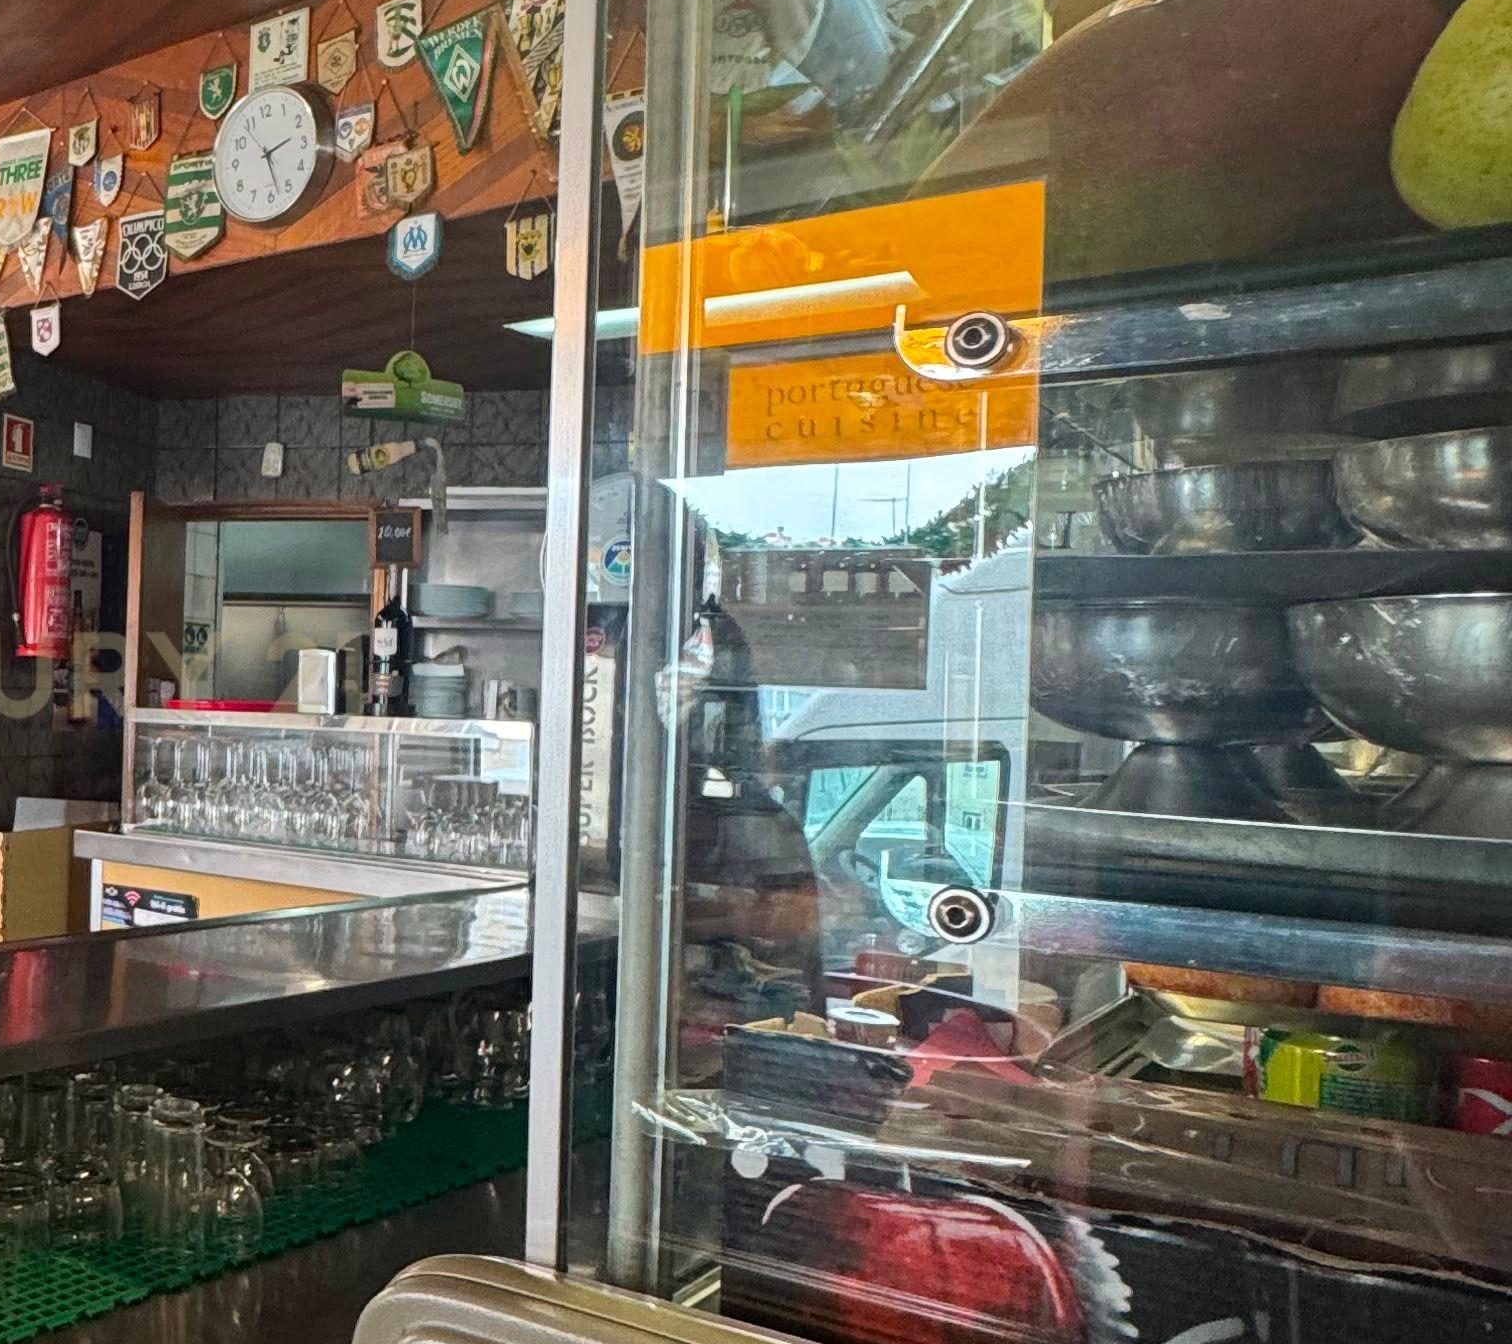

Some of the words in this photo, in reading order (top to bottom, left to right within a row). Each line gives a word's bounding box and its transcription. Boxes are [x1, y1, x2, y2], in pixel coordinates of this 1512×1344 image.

[259, 104, 272, 118] 12
[281, 104, 286, 116] 1
[246, 116, 256, 130] 11
[295, 115, 302, 129] 2
[234, 136, 247, 151] 10
[300, 136, 308, 149] 3
[231, 159, 240, 172] 9
[297, 158, 305, 171] 4
[0, 159, 43, 187] THREE
[236, 179, 244, 192] 8
[284, 179, 292, 193] 5
[250, 189, 257, 202] 7
[267, 191, 275, 203] 6
[767, 374, 973, 417] portugue
[766, 402, 975, 439] cuisine
